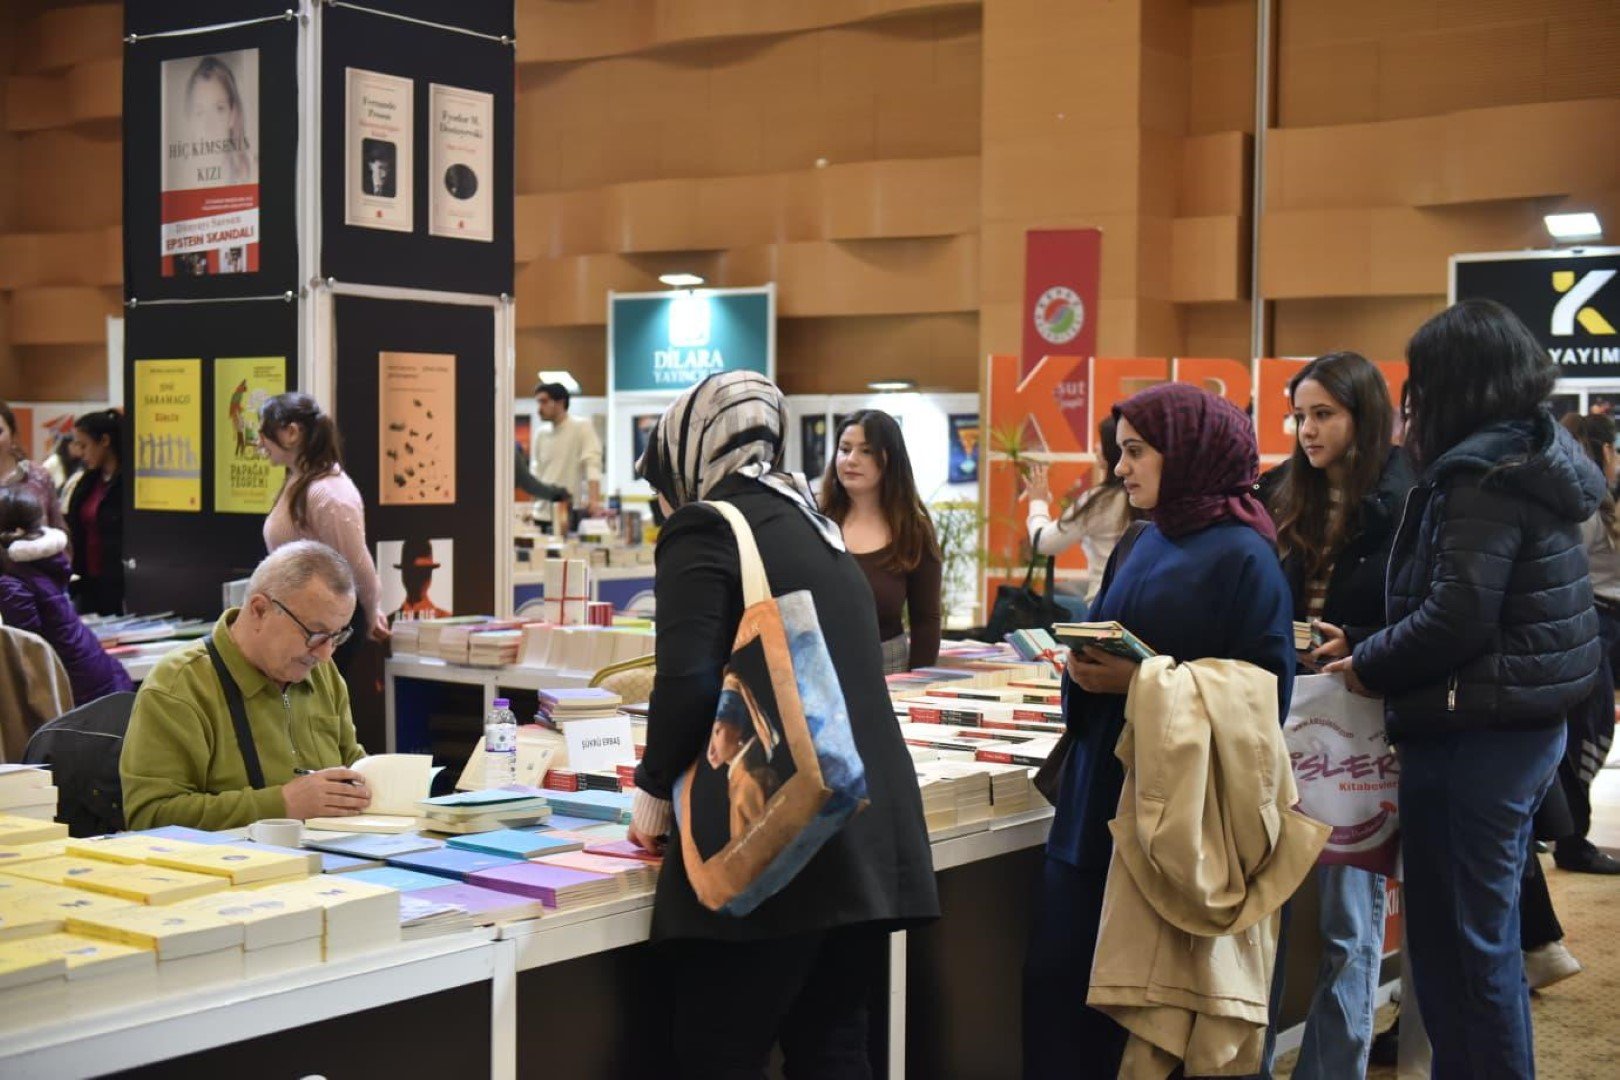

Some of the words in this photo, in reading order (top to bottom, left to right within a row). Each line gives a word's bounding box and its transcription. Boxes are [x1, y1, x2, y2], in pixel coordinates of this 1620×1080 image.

[168, 140, 189, 160] HİÇ
[197, 166, 222, 182] KIZI
[166, 234, 204, 250] EPSTEIN
[206, 225, 254, 243] SKANDALI
[654, 346, 724, 368] DİLARA
[581, 737, 602, 750] ŞÜKRÜ
[602, 736, 621, 747] ERBAŞ
